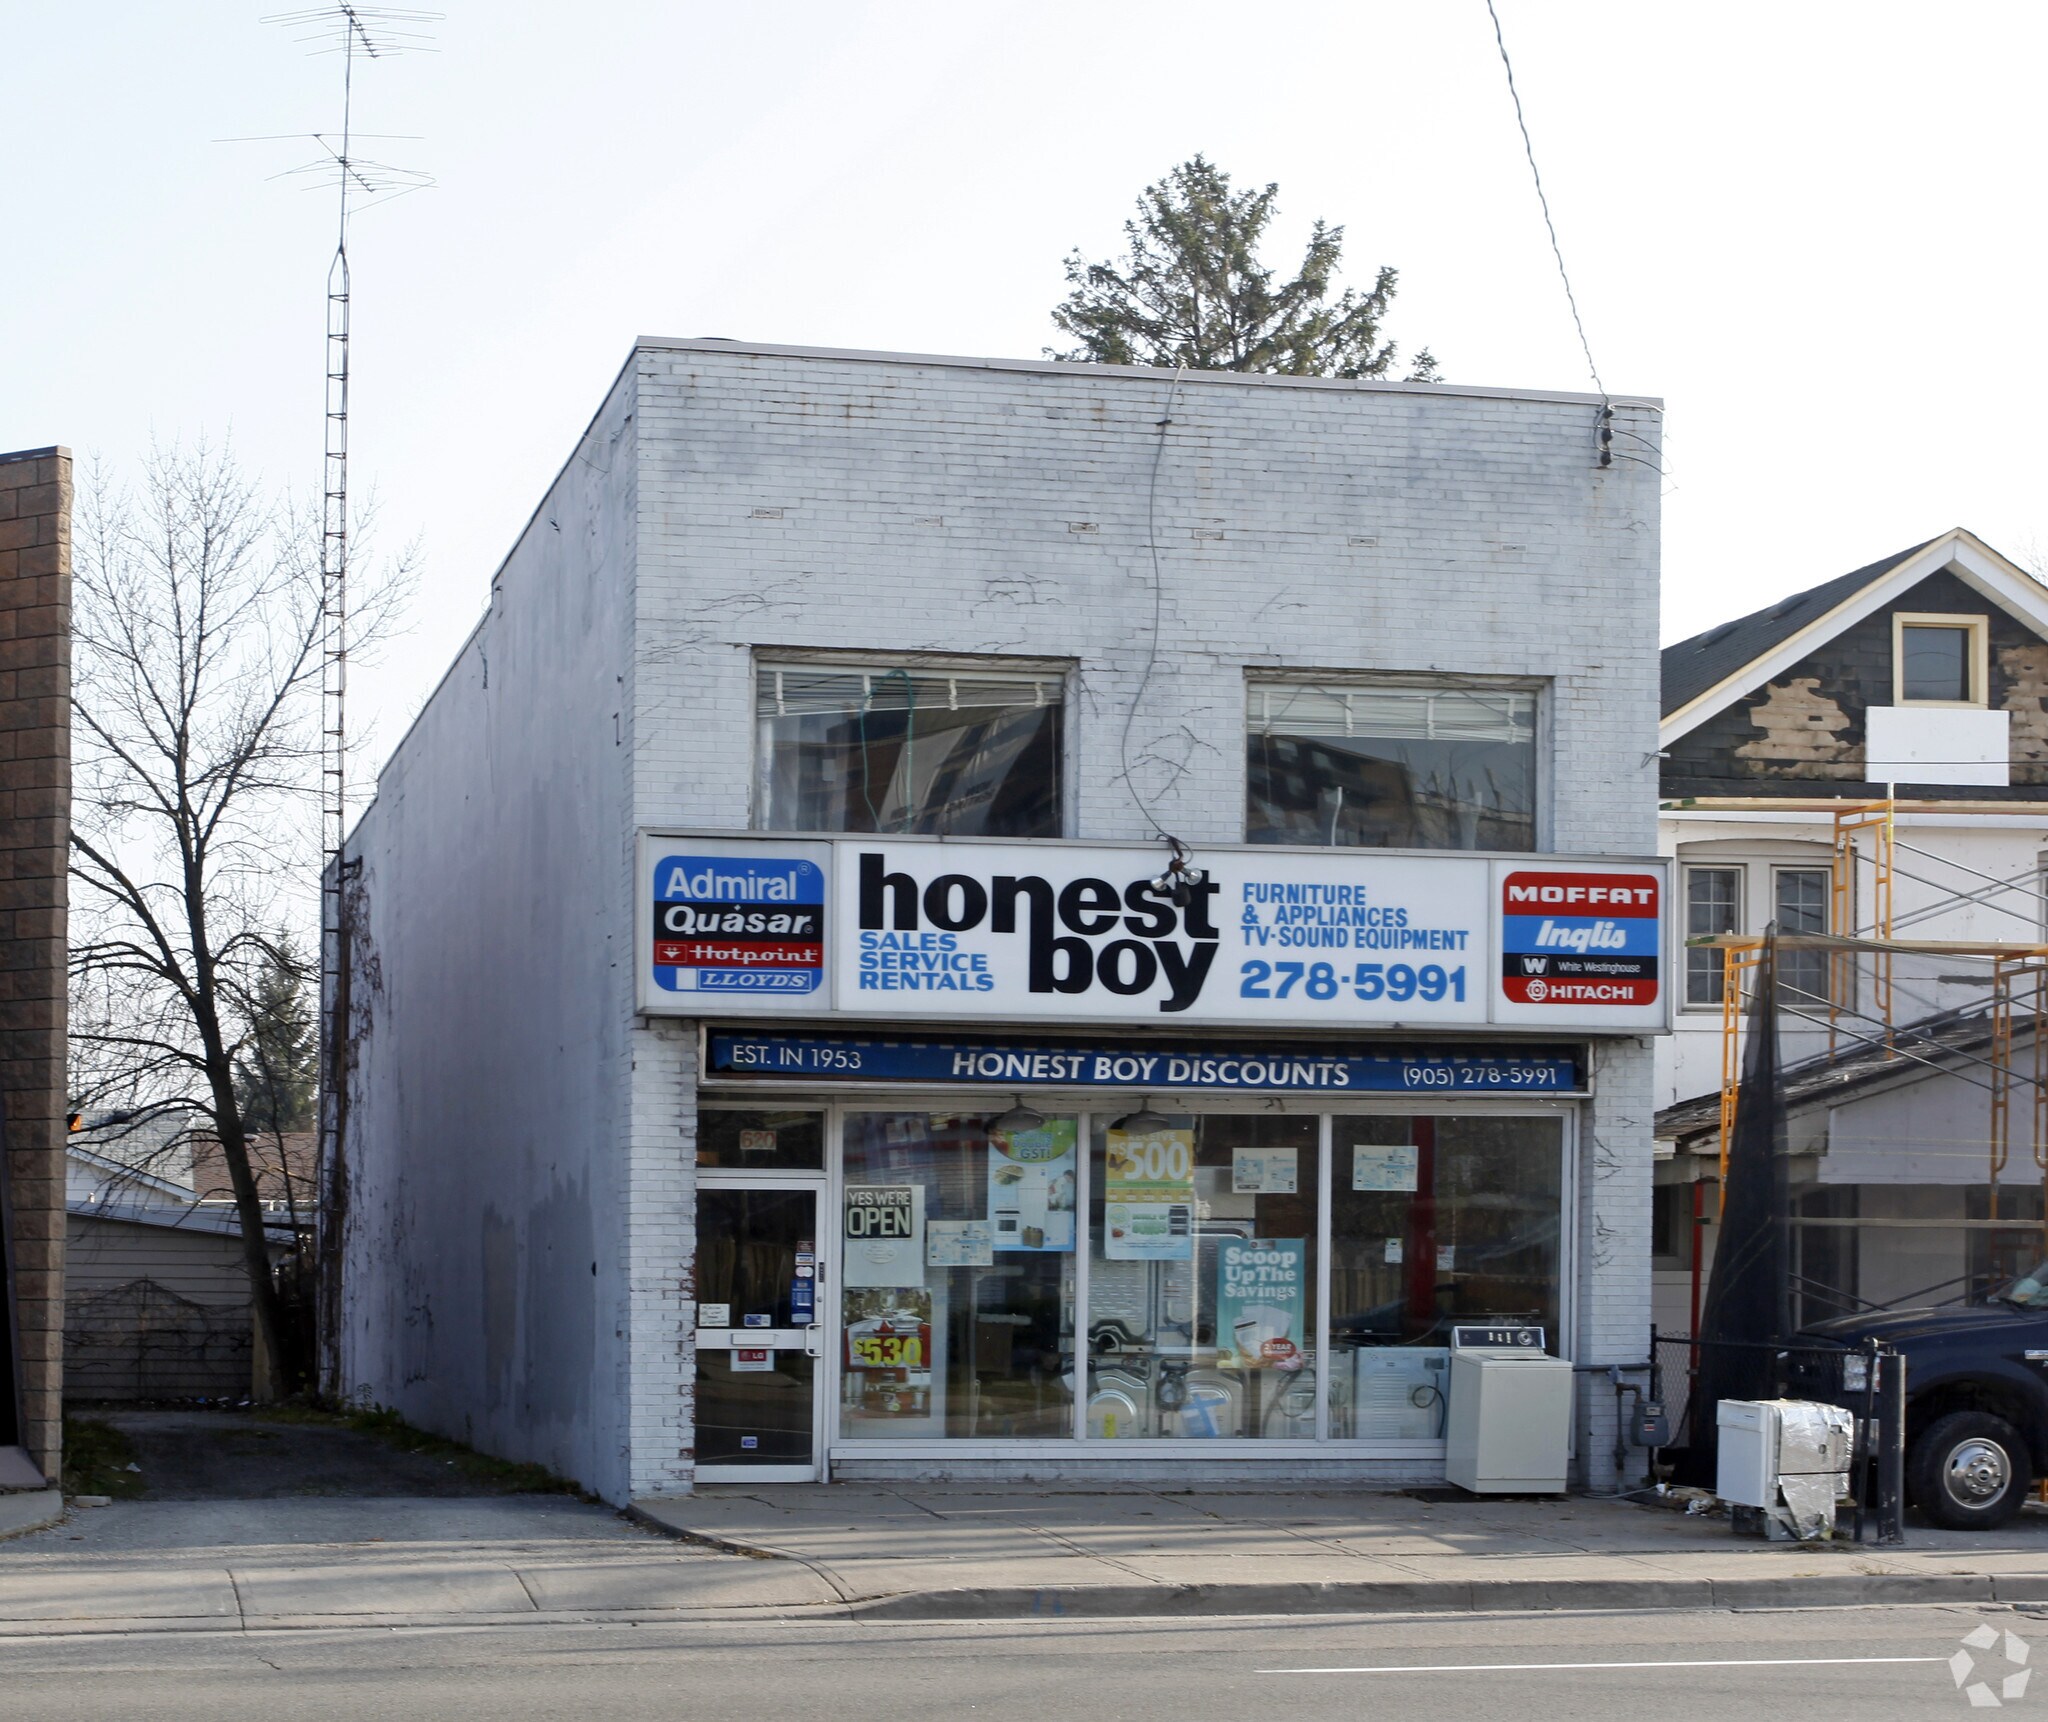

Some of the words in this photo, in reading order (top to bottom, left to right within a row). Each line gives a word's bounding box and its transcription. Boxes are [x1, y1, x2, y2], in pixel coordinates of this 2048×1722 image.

[665, 867, 797, 900] Admiral
[860, 853, 1220, 939] honest
[1243, 883, 1366, 906] FURNITURE
[1509, 885, 1654, 905] MOFFAT
[664, 905, 812, 934] Quasar
[1242, 904, 1260, 925] &
[1274, 907, 1408, 928] APPLIANCES
[860, 932, 957, 951] SALES
[1355, 929, 1469, 950] EQUIPMENT
[1535, 920, 1627, 953] Inglis
[689, 945, 818, 965] Hotpoint
[860, 952, 987, 972] SERVICE
[1029, 936, 1220, 1012] boy
[1558, 962, 1582, 972] White
[1584, 962, 1641, 975] Westinghouse
[860, 971, 994, 991] RENTALS
[1551, 985, 1634, 999] HITACHI
[732, 1045, 770, 1065] EST.
[779, 1047, 804, 1066] IN
[811, 1049, 862, 1069] 1953
[952, 1052, 1084, 1079] HONEST
[1094, 1057, 1159, 1081] BOY
[1168, 1059, 1350, 1086] DISCOUNTS
[1404, 1065, 1455, 1087] (905)
[1461, 1067, 1557, 1085] 278-5991
[848, 1191, 874, 1206] YES
[847, 1206, 911, 1235] OPEN
[1225, 1247, 1297, 1268] Scoop
[1225, 1266, 1256, 1285] Up
[1256, 1266, 1296, 1281] The
[1224, 1282, 1297, 1300] Savings
[752, 1352, 765, 1360] LG
[853, 1336, 922, 1366] $530
